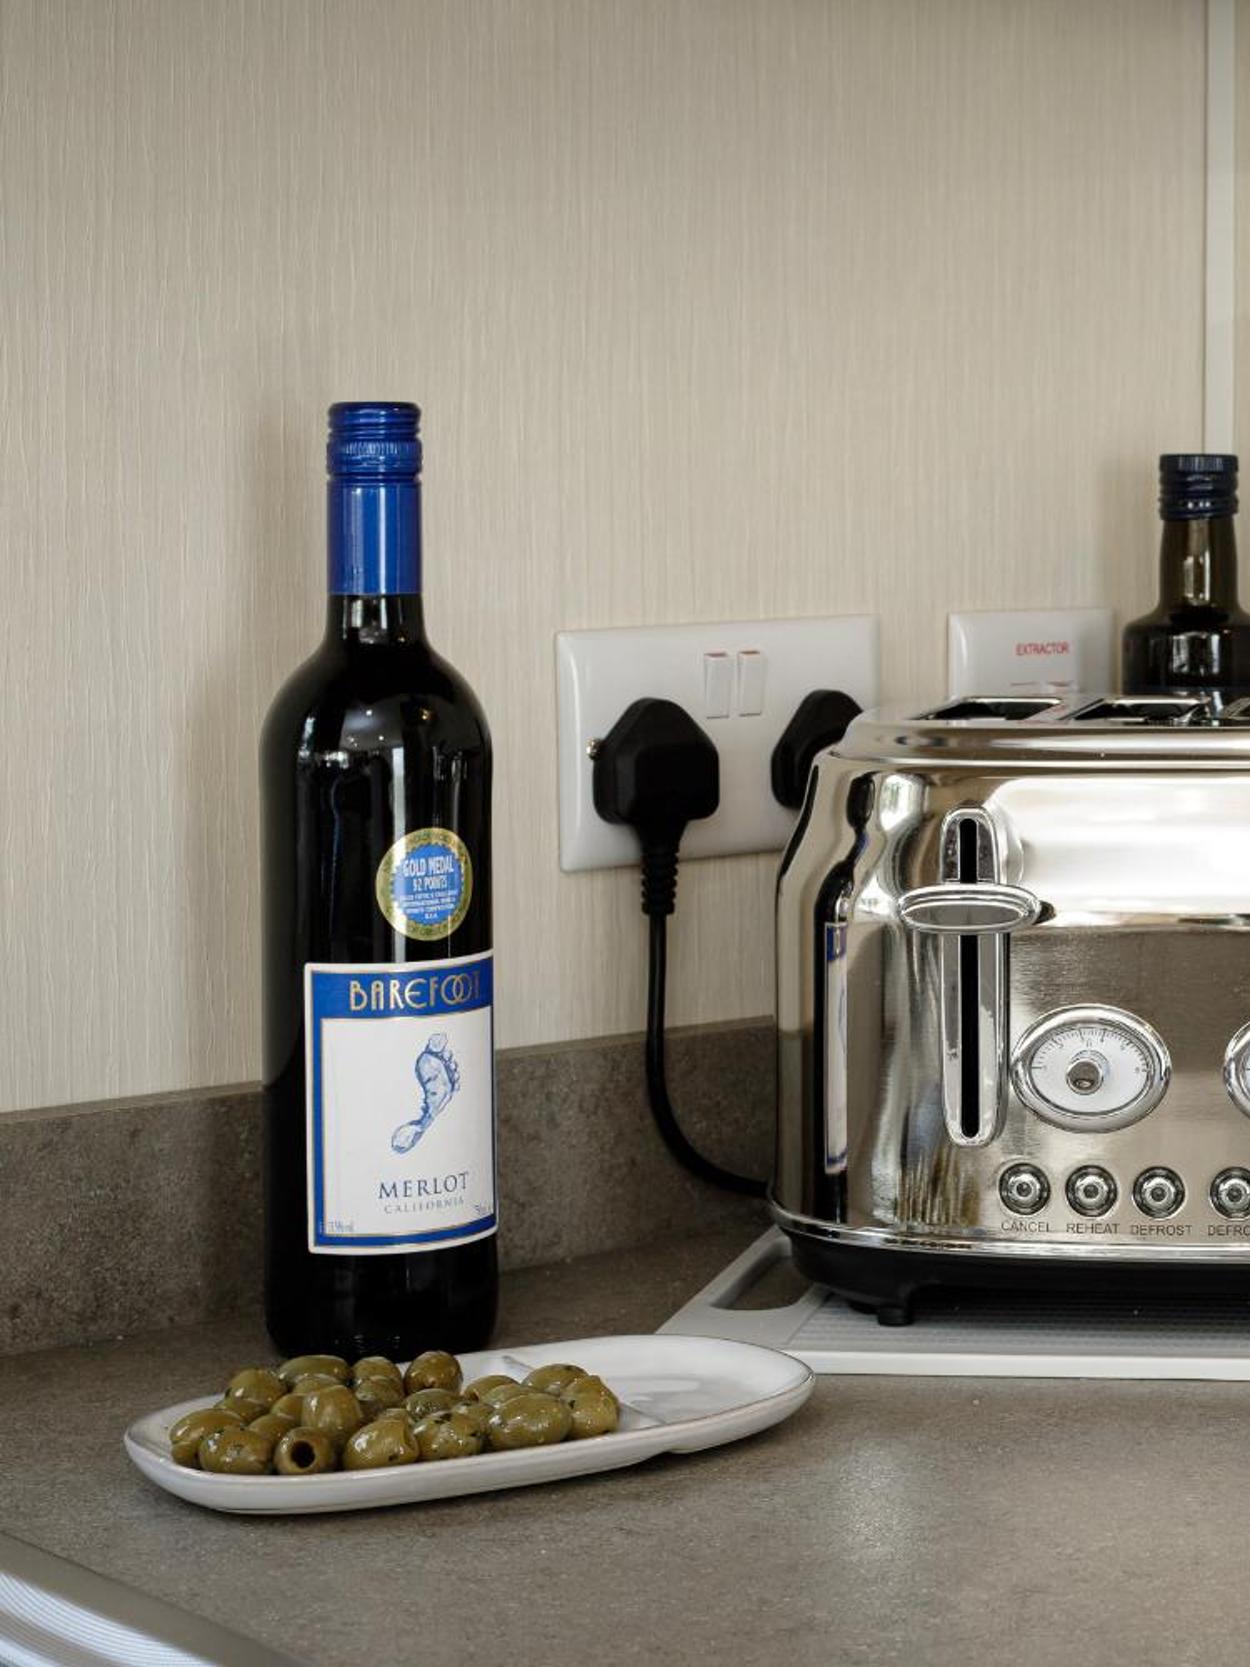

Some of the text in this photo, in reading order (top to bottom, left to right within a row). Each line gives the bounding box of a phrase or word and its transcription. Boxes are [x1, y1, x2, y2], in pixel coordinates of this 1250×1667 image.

[1015, 641, 1069, 656] EXTRACTOR
[403, 854, 454, 877] GOLD MEDAL
[348, 972, 480, 1011] BAREFOOT
[378, 1171, 470, 1200] MERLOT
[384, 1195, 465, 1214] CALIFORNIA
[1000, 1220, 1052, 1233] CANCEL
[1065, 1222, 1120, 1235] REHEAT
[1130, 1223, 1192, 1237] DEFROST
